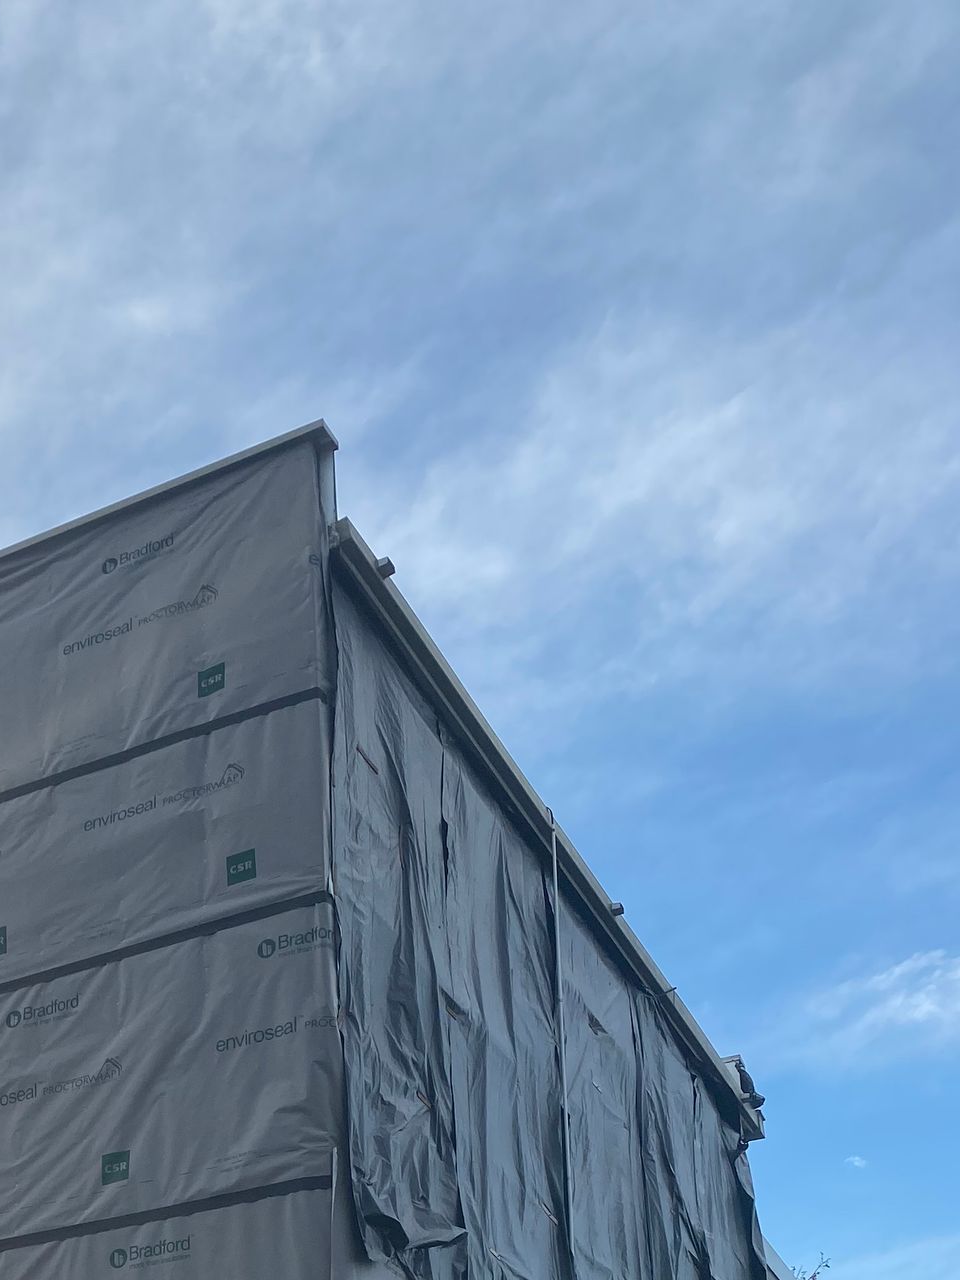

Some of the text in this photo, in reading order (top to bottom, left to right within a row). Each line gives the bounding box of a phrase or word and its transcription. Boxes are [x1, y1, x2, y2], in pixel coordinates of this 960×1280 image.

[119, 533, 174, 565] Bradford
[63, 619, 133, 656] enviroseal
[201, 672, 223, 688] CSR
[83, 796, 157, 833] enviroseal
[230, 860, 253, 874] CSR
[279, 926, 334, 950] Bradfor
[23, 992, 79, 1020] Bradford
[216, 1017, 298, 1052] enviroseal
[104, 1162, 127, 1174] CSR
[129, 1235, 191, 1260] Bradford
